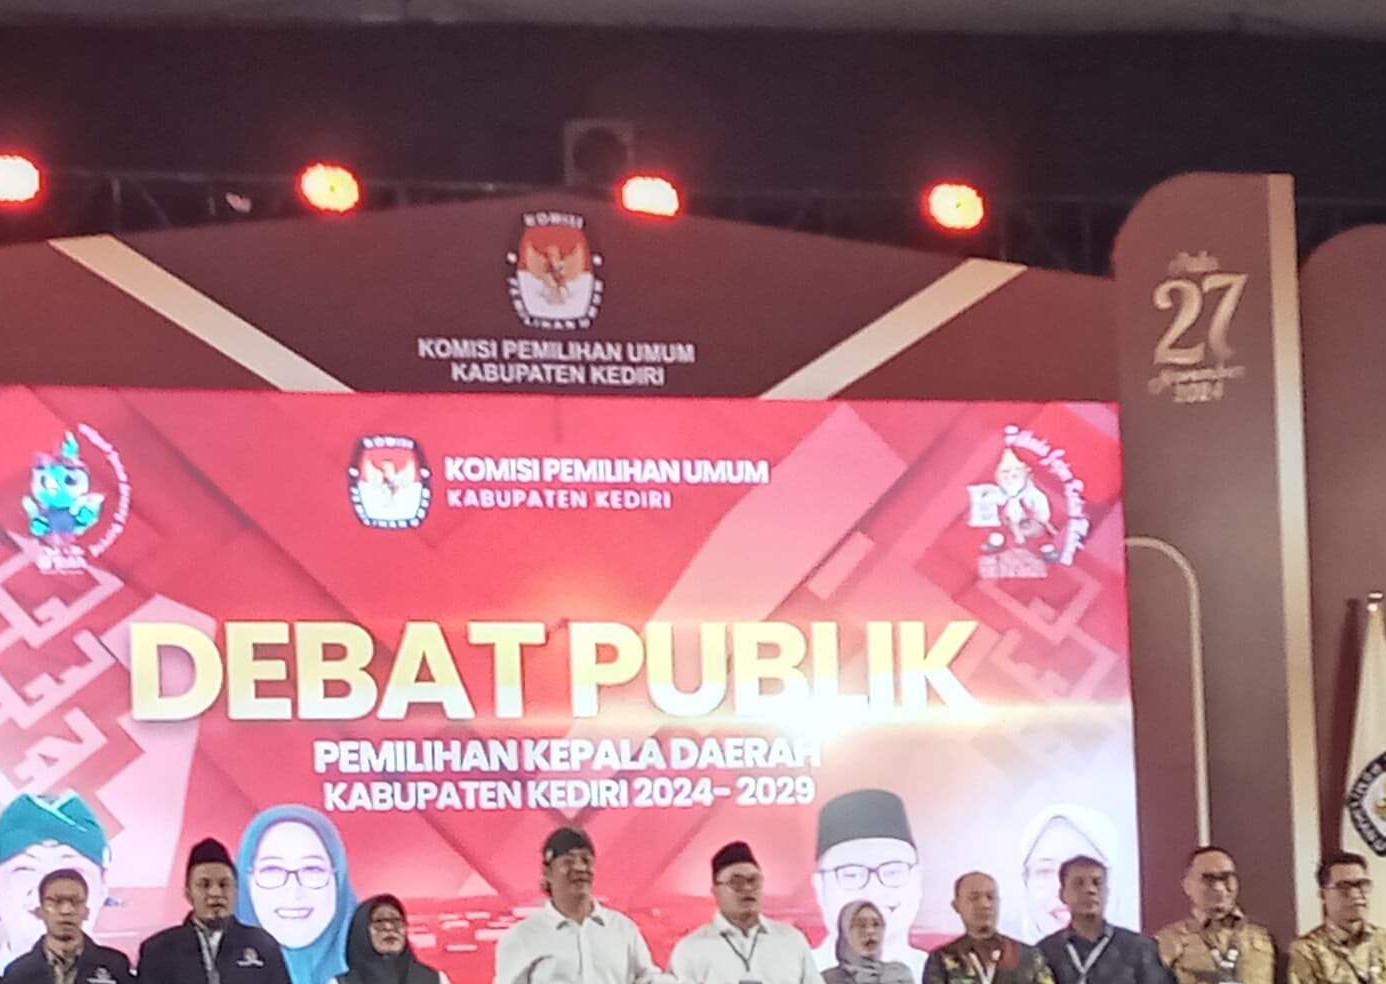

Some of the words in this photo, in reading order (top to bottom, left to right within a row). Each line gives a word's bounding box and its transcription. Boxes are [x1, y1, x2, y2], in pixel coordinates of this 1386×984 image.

[1154, 272, 1249, 366] 27
[418, 338, 498, 359] KOMISI
[502, 339, 623, 362] PEMILIHAN
[627, 343, 696, 364] UMUM
[451, 362, 586, 385] KABUPATEN
[590, 366, 666, 386] KEDIRI
[444, 457, 541, 482] KOMISI
[543, 458, 681, 484] PEMILIHAN
[682, 460, 769, 484] UMUM
[447, 489, 589, 509] KABUPATEN
[594, 490, 672, 509] KEDIRI
[129, 621, 547, 721] DEBAT
[567, 621, 983, 718] PUBLIK
[313, 739, 515, 774] PEMILIHAN
[523, 738, 667, 772] KEPALA
[669, 737, 822, 770] DAERAH
[322, 780, 526, 811] KABUPATEN
[527, 778, 628, 808] KEDIRI
[736, 776, 816, 805] 2029
